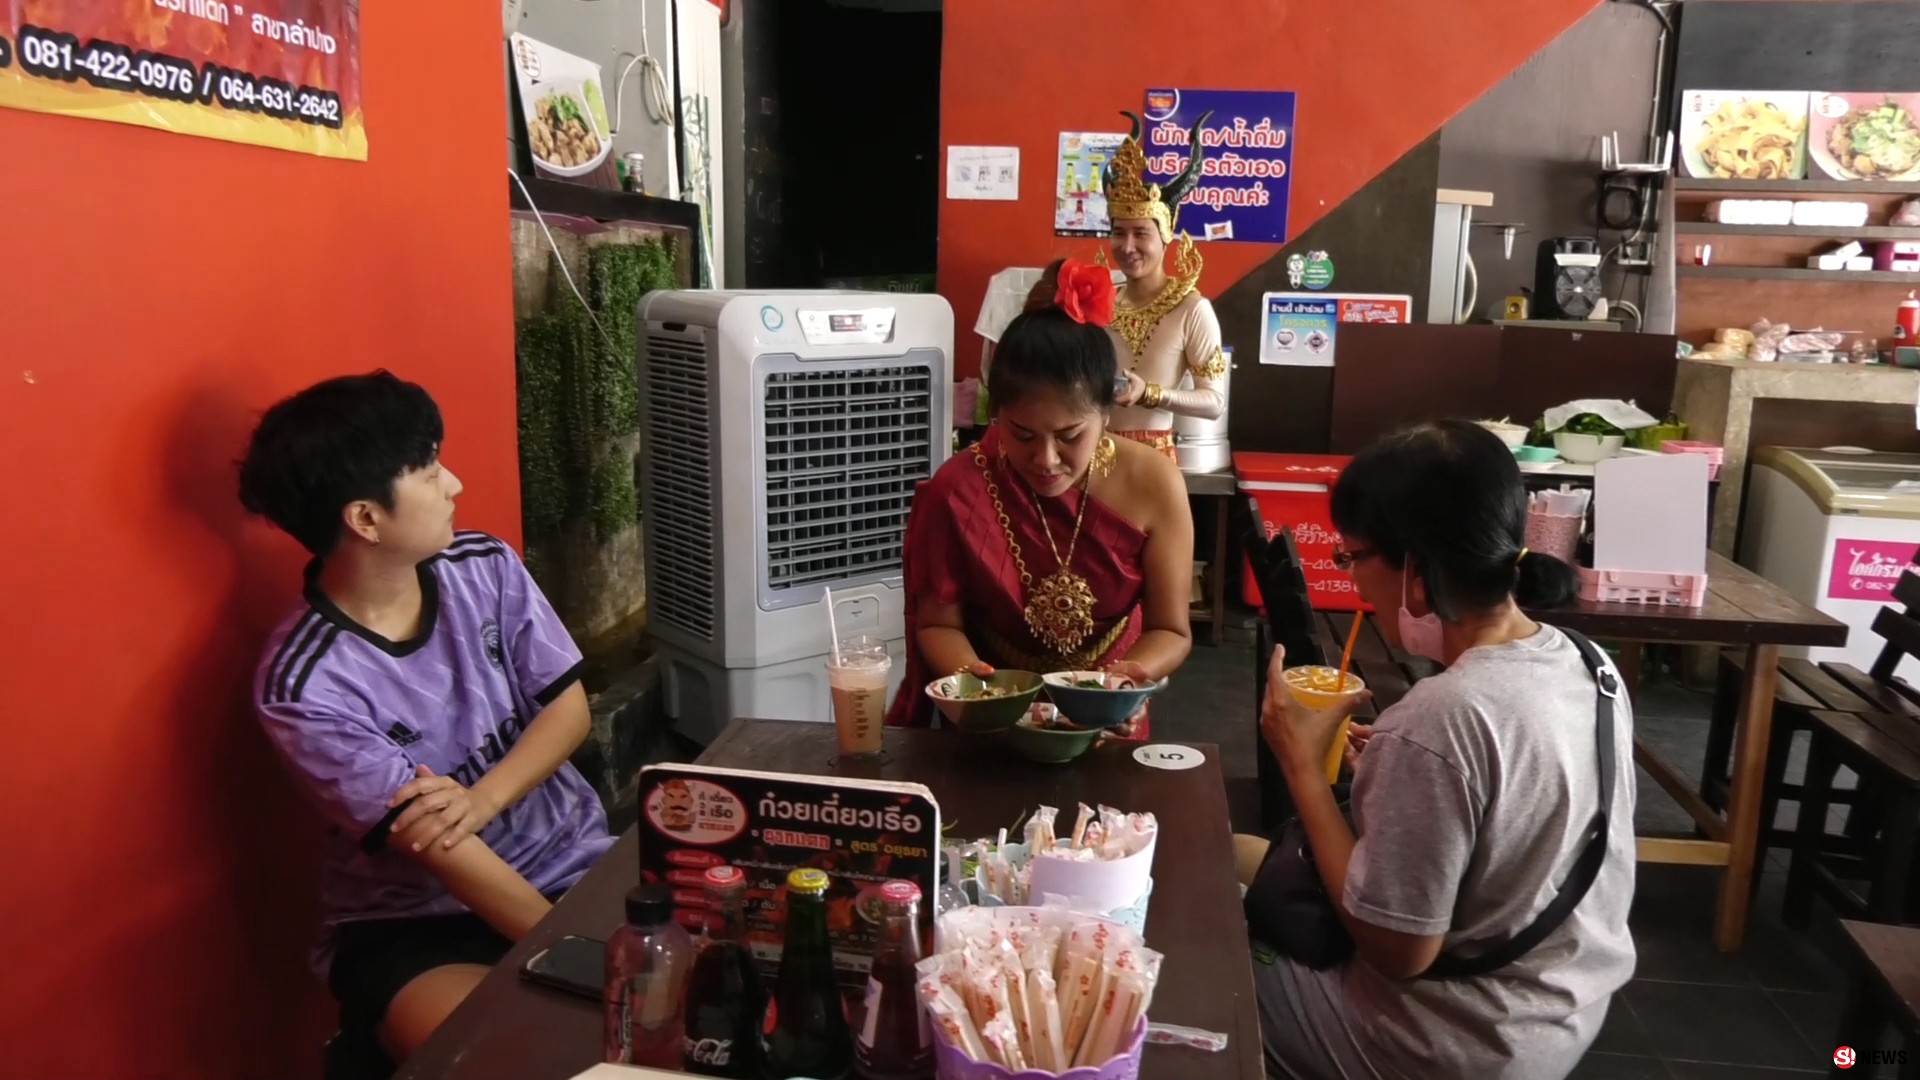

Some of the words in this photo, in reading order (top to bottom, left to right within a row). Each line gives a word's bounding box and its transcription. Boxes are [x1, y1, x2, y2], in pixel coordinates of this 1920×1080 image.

[252, 13, 336, 54] สาขาลำปาง
[24, 36, 193, 93] 081-422-0976
[220, 76, 339, 121] 064-631-2642
[1152, 117, 1286, 148] ผักด/น้ำดื่ม
[1148, 152, 1286, 178] บริกรตัวเอง
[1179, 181, 1269, 212] บคุณค่ะ
[759, 791, 922, 833] ก๋วยเตี๋ยวเรือ
